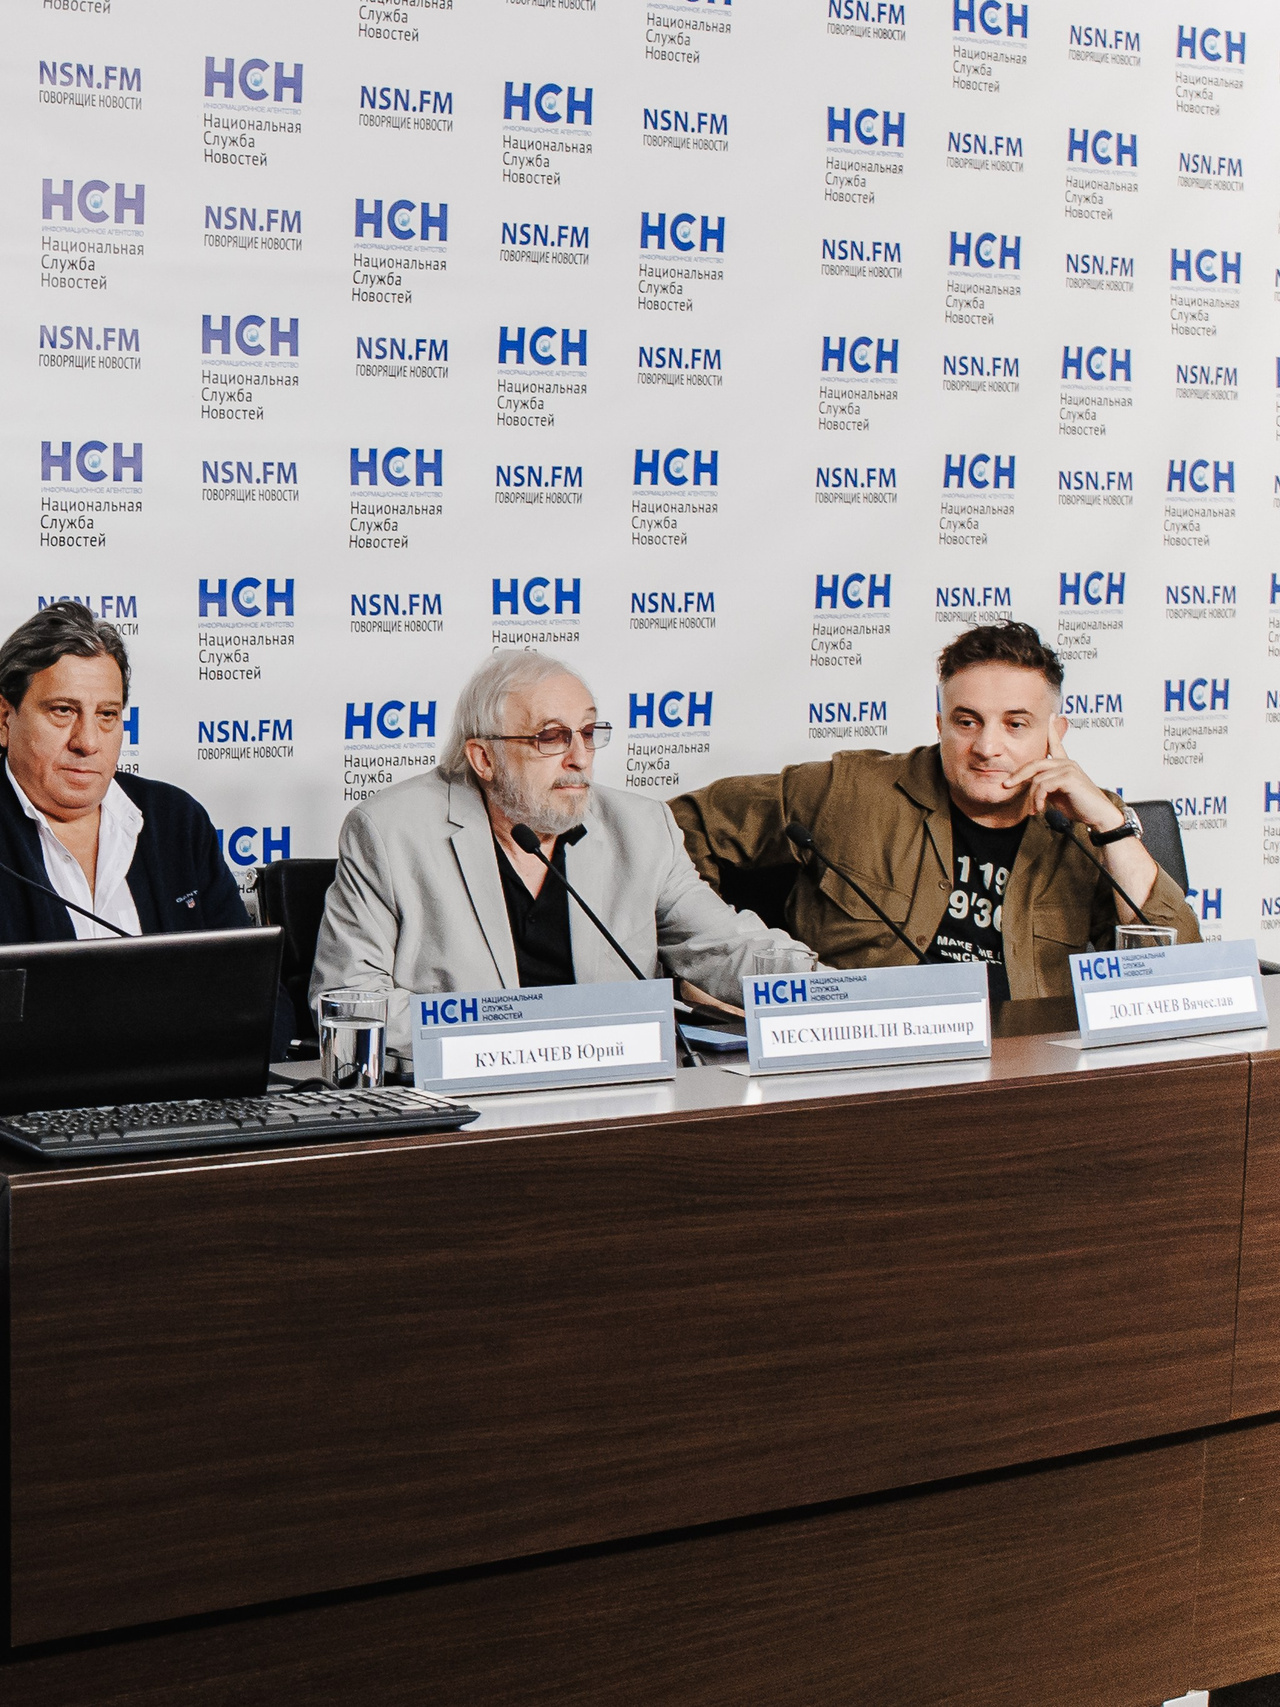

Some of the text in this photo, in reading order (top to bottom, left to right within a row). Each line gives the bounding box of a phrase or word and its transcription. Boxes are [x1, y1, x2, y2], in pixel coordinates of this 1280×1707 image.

[358, 8, 408, 26] Служба
[646, 13, 732, 34] Национальная
[358, 24, 419, 42] Новостей
[645, 30, 691, 47] Служба
[645, 46, 700, 64] Новостей
[39, 60, 141, 92] NSN.FM
[204, 56, 303, 103] НСН
[39, 90, 142, 110] ГОВОРЯЩИЕ НОВОСТИ
[360, 86, 453, 115] NSN.FM
[503, 81, 593, 125] НСН
[644, 108, 728, 135] NSN.FM
[827, 106, 905, 148] НСН
[503, 135, 592, 154] Национальная
[948, 132, 1023, 157] NSN.FM
[1067, 128, 1138, 167] НСН
[503, 152, 549, 169] Служба
[826, 156, 903, 174] Национальная
[503, 169, 560, 185] Новостей
[825, 172, 866, 189] Служба
[42, 178, 145, 225] НСН
[825, 188, 874, 204] Новостей
[205, 206, 301, 233] NSN.FM
[355, 198, 448, 242] НСН
[501, 222, 589, 249] NSN.FM
[640, 212, 725, 253] НСН
[500, 249, 589, 265] ГОВОРЯЩИЕ НОВОСТИ
[822, 239, 901, 263] NSN.FM
[949, 231, 1021, 270] НСН
[639, 264, 723, 280] Национальная
[821, 264, 902, 278] ГОВОРЯЩИЕ НОВОСТИ
[638, 280, 683, 297] Служба
[947, 280, 1021, 295] Национальная
[638, 296, 692, 311] Новостей
[946, 295, 984, 311] Служба
[945, 311, 994, 325] Новостей
[40, 325, 140, 352] NSN.FM
[202, 314, 299, 357] НСН
[498, 326, 587, 366] НСН
[357, 337, 448, 362] NSN.FM
[639, 346, 721, 370] NSN.FM
[821, 336, 899, 374] НСН
[39, 354, 141, 370] ГОВОРЯЩИЕ НОВОСТИ
[944, 355, 1019, 378] NSN.FM
[1061, 346, 1132, 382] НСН
[638, 373, 722, 387] ГОВОРЯЩИЕ НОВОСТИ
[41, 440, 143, 482] НСН
[350, 446, 443, 487] НСН
[633, 448, 719, 486] НСН
[943, 453, 1016, 489] НСН
[202, 461, 298, 484] NSN.FM
[496, 465, 582, 487] NSN.FM
[816, 467, 896, 488] NSN.FM
[202, 488, 299, 503] ГОВОРЯЩИЕ НОВОСТИ
[351, 501, 442, 517] Национальная
[350, 518, 398, 535] Служба
[349, 535, 408, 548] Новостей
[198, 577, 295, 617] НСН
[492, 577, 581, 615] НСН
[815, 573, 891, 609] НСН
[936, 587, 1011, 608] NSN.FM
[1059, 571, 1125, 606] НСН
[1166, 585, 1236, 604] NSN.FM
[351, 594, 442, 616] NSN.FM
[631, 592, 715, 613] NSN.FM
[351, 620, 443, 634] ГОВОРЯЩИЕ НОВОСТИ
[492, 630, 580, 645] Национальная
[1061, 694, 1122, 714] SN.FM
[1164, 678, 1230, 712] НСН
[344, 700, 437, 740] НСН
[629, 690, 713, 729] НСН
[809, 701, 887, 723] NSN.FM
[198, 719, 293, 743] NSN.FM
[628, 743, 710, 756] Национальная
[344, 753, 436, 771] Национальная
[627, 757, 670, 774] Служба
[344, 770, 393, 787] Служба
[626, 773, 679, 787] Новостей
[1171, 796, 1226, 816] SN.FM
[216, 826, 290, 866] СН
[937, 935, 973, 952] MAKE
[1079, 956, 1120, 981] НСН
[482, 993, 543, 1004] НАЦИОНАЛЬНАЯ
[754, 980, 807, 1005] НСН
[421, 998, 479, 1026] НСН
[482, 1004, 513, 1013] СЛУЖБА
[482, 1011, 523, 1022] НОВОСТЕЙ
[771, 1020, 974, 1045] МЕСХИШВИЛИ Владимир
[475, 1042, 624, 1068] КУКЛАЧЕВ Юрий
